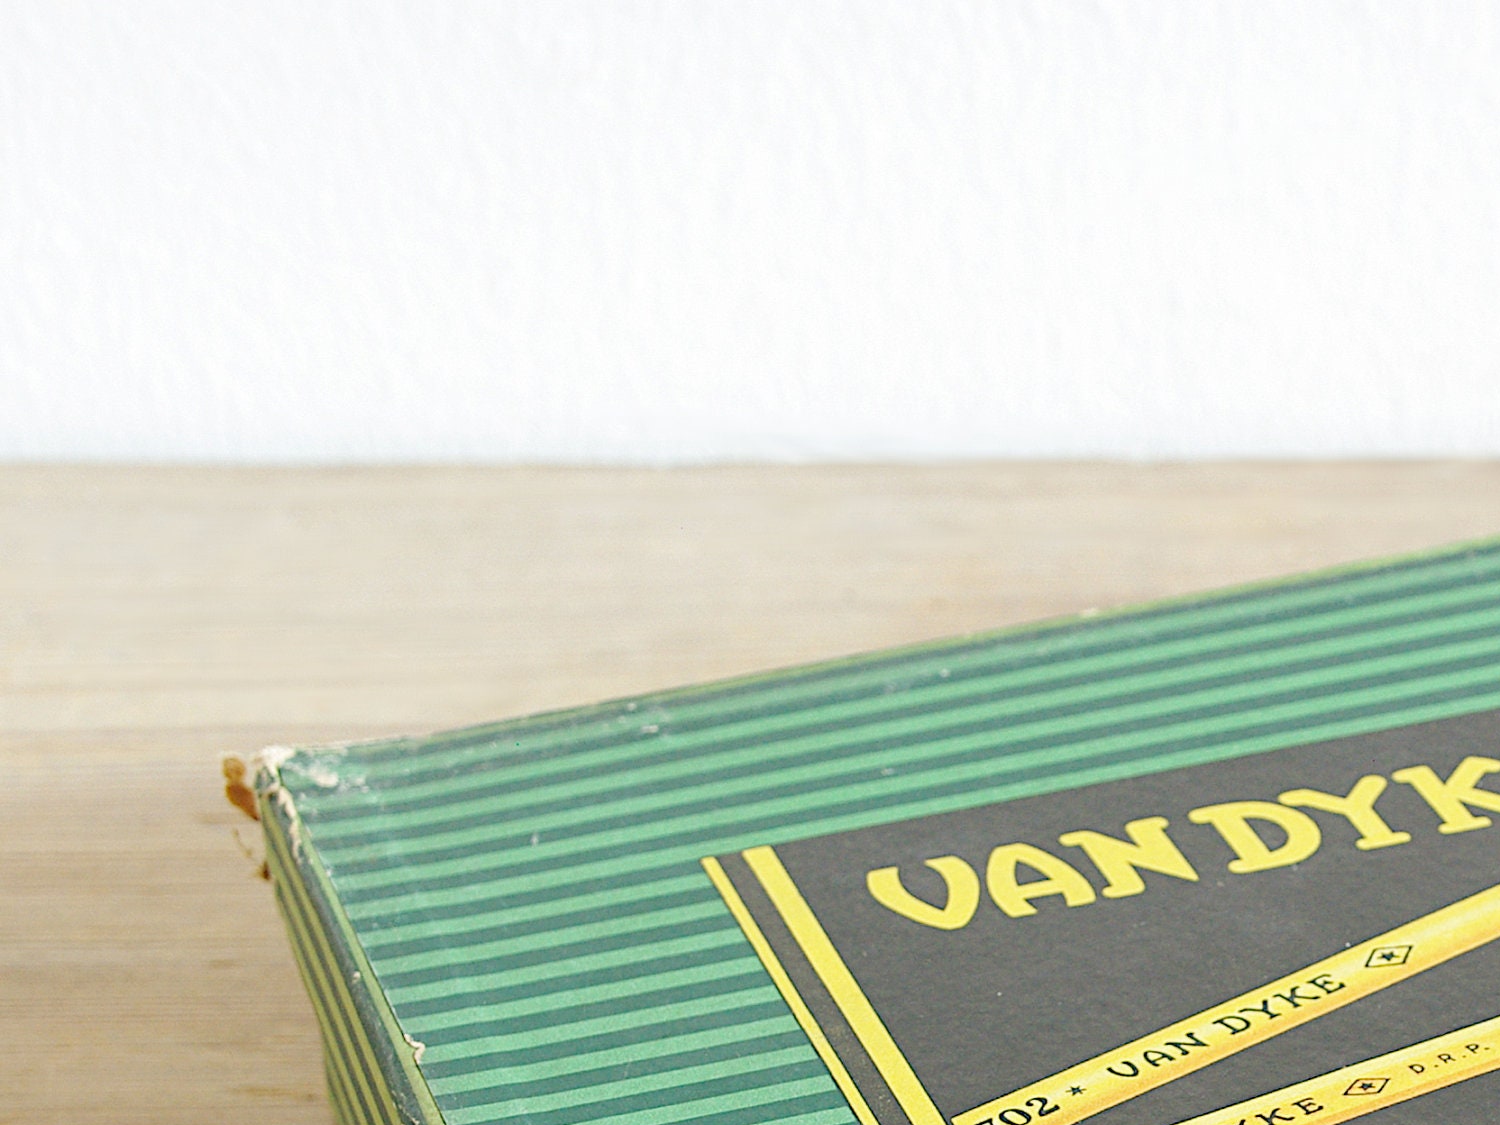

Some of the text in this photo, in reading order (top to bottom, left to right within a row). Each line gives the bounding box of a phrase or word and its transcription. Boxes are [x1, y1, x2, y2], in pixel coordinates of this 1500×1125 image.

[866, 815, 1200, 931] VAN
[1106, 1032, 1210, 1078] VAN
[1212, 972, 1346, 1036] DYKE
